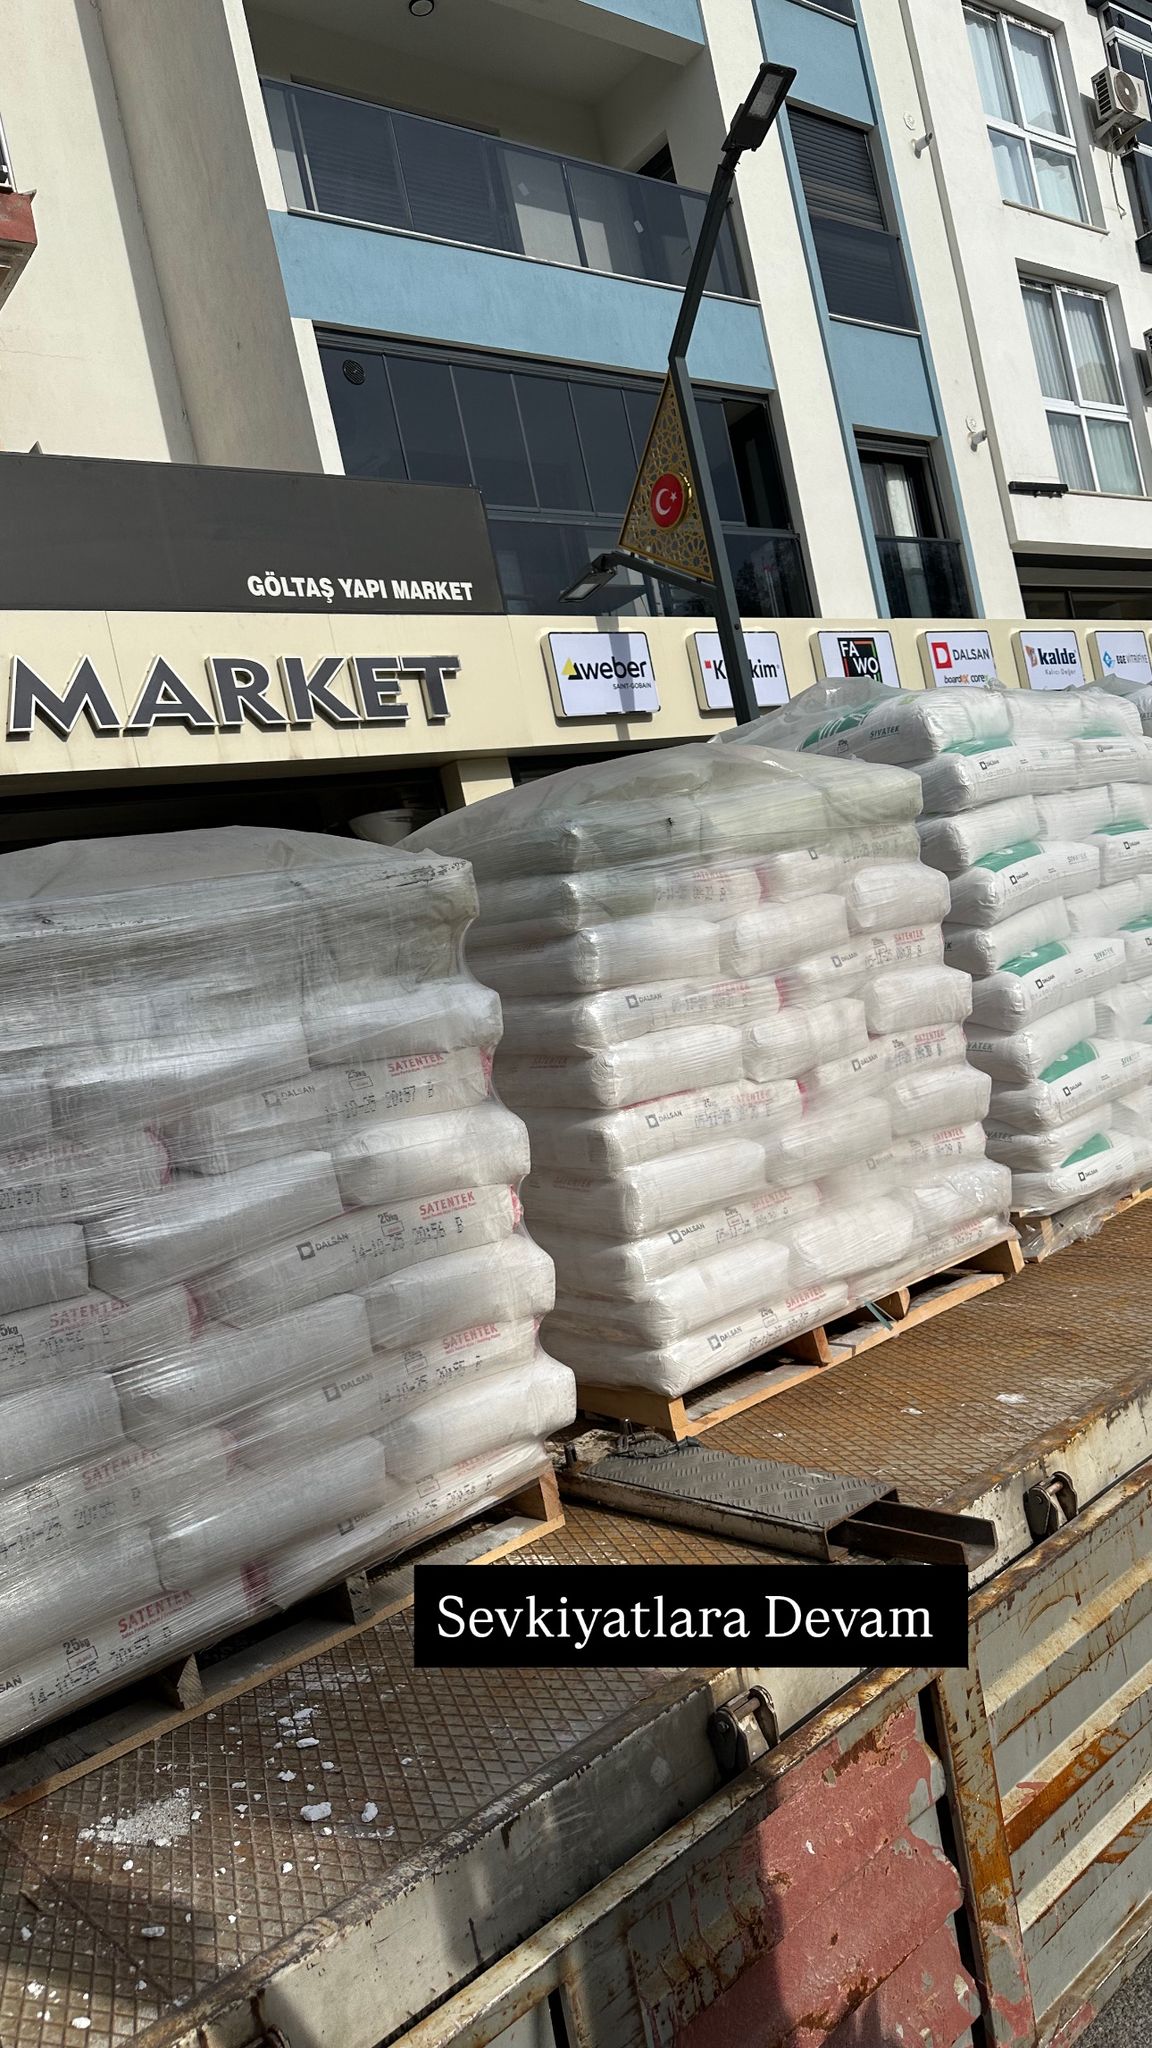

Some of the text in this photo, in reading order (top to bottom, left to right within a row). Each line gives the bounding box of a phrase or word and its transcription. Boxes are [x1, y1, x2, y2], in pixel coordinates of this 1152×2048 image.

[247, 571, 473, 602] GÖLTAŞ YAPI MARKET
[840, 641, 859, 657] FA
[952, 649, 990, 661] DALSAN
[1037, 648, 1077, 665] kalde
[579, 656, 648, 680] weber
[713, 659, 778, 680] Kkim
[853, 656, 879, 674] WO
[7, 655, 463, 737] MARKET
[612, 682, 652, 691] SAINT-GOBAIN
[870, 726, 900, 738] SIVATEK
[387, 1052, 444, 1074] SATENTEK
[419, 1191, 476, 1216] SATENTEK
[680, 1222, 706, 1237] DALSAN
[314, 1232, 350, 1251] DALSAN
[442, 1322, 498, 1350] SATENTEK
[720, 1325, 743, 1342] DALSAN
[340, 1372, 374, 1392] DALSAN
[118, 1589, 193, 1634] SATENTEK
[63, 1637, 91, 1656] 25kg
